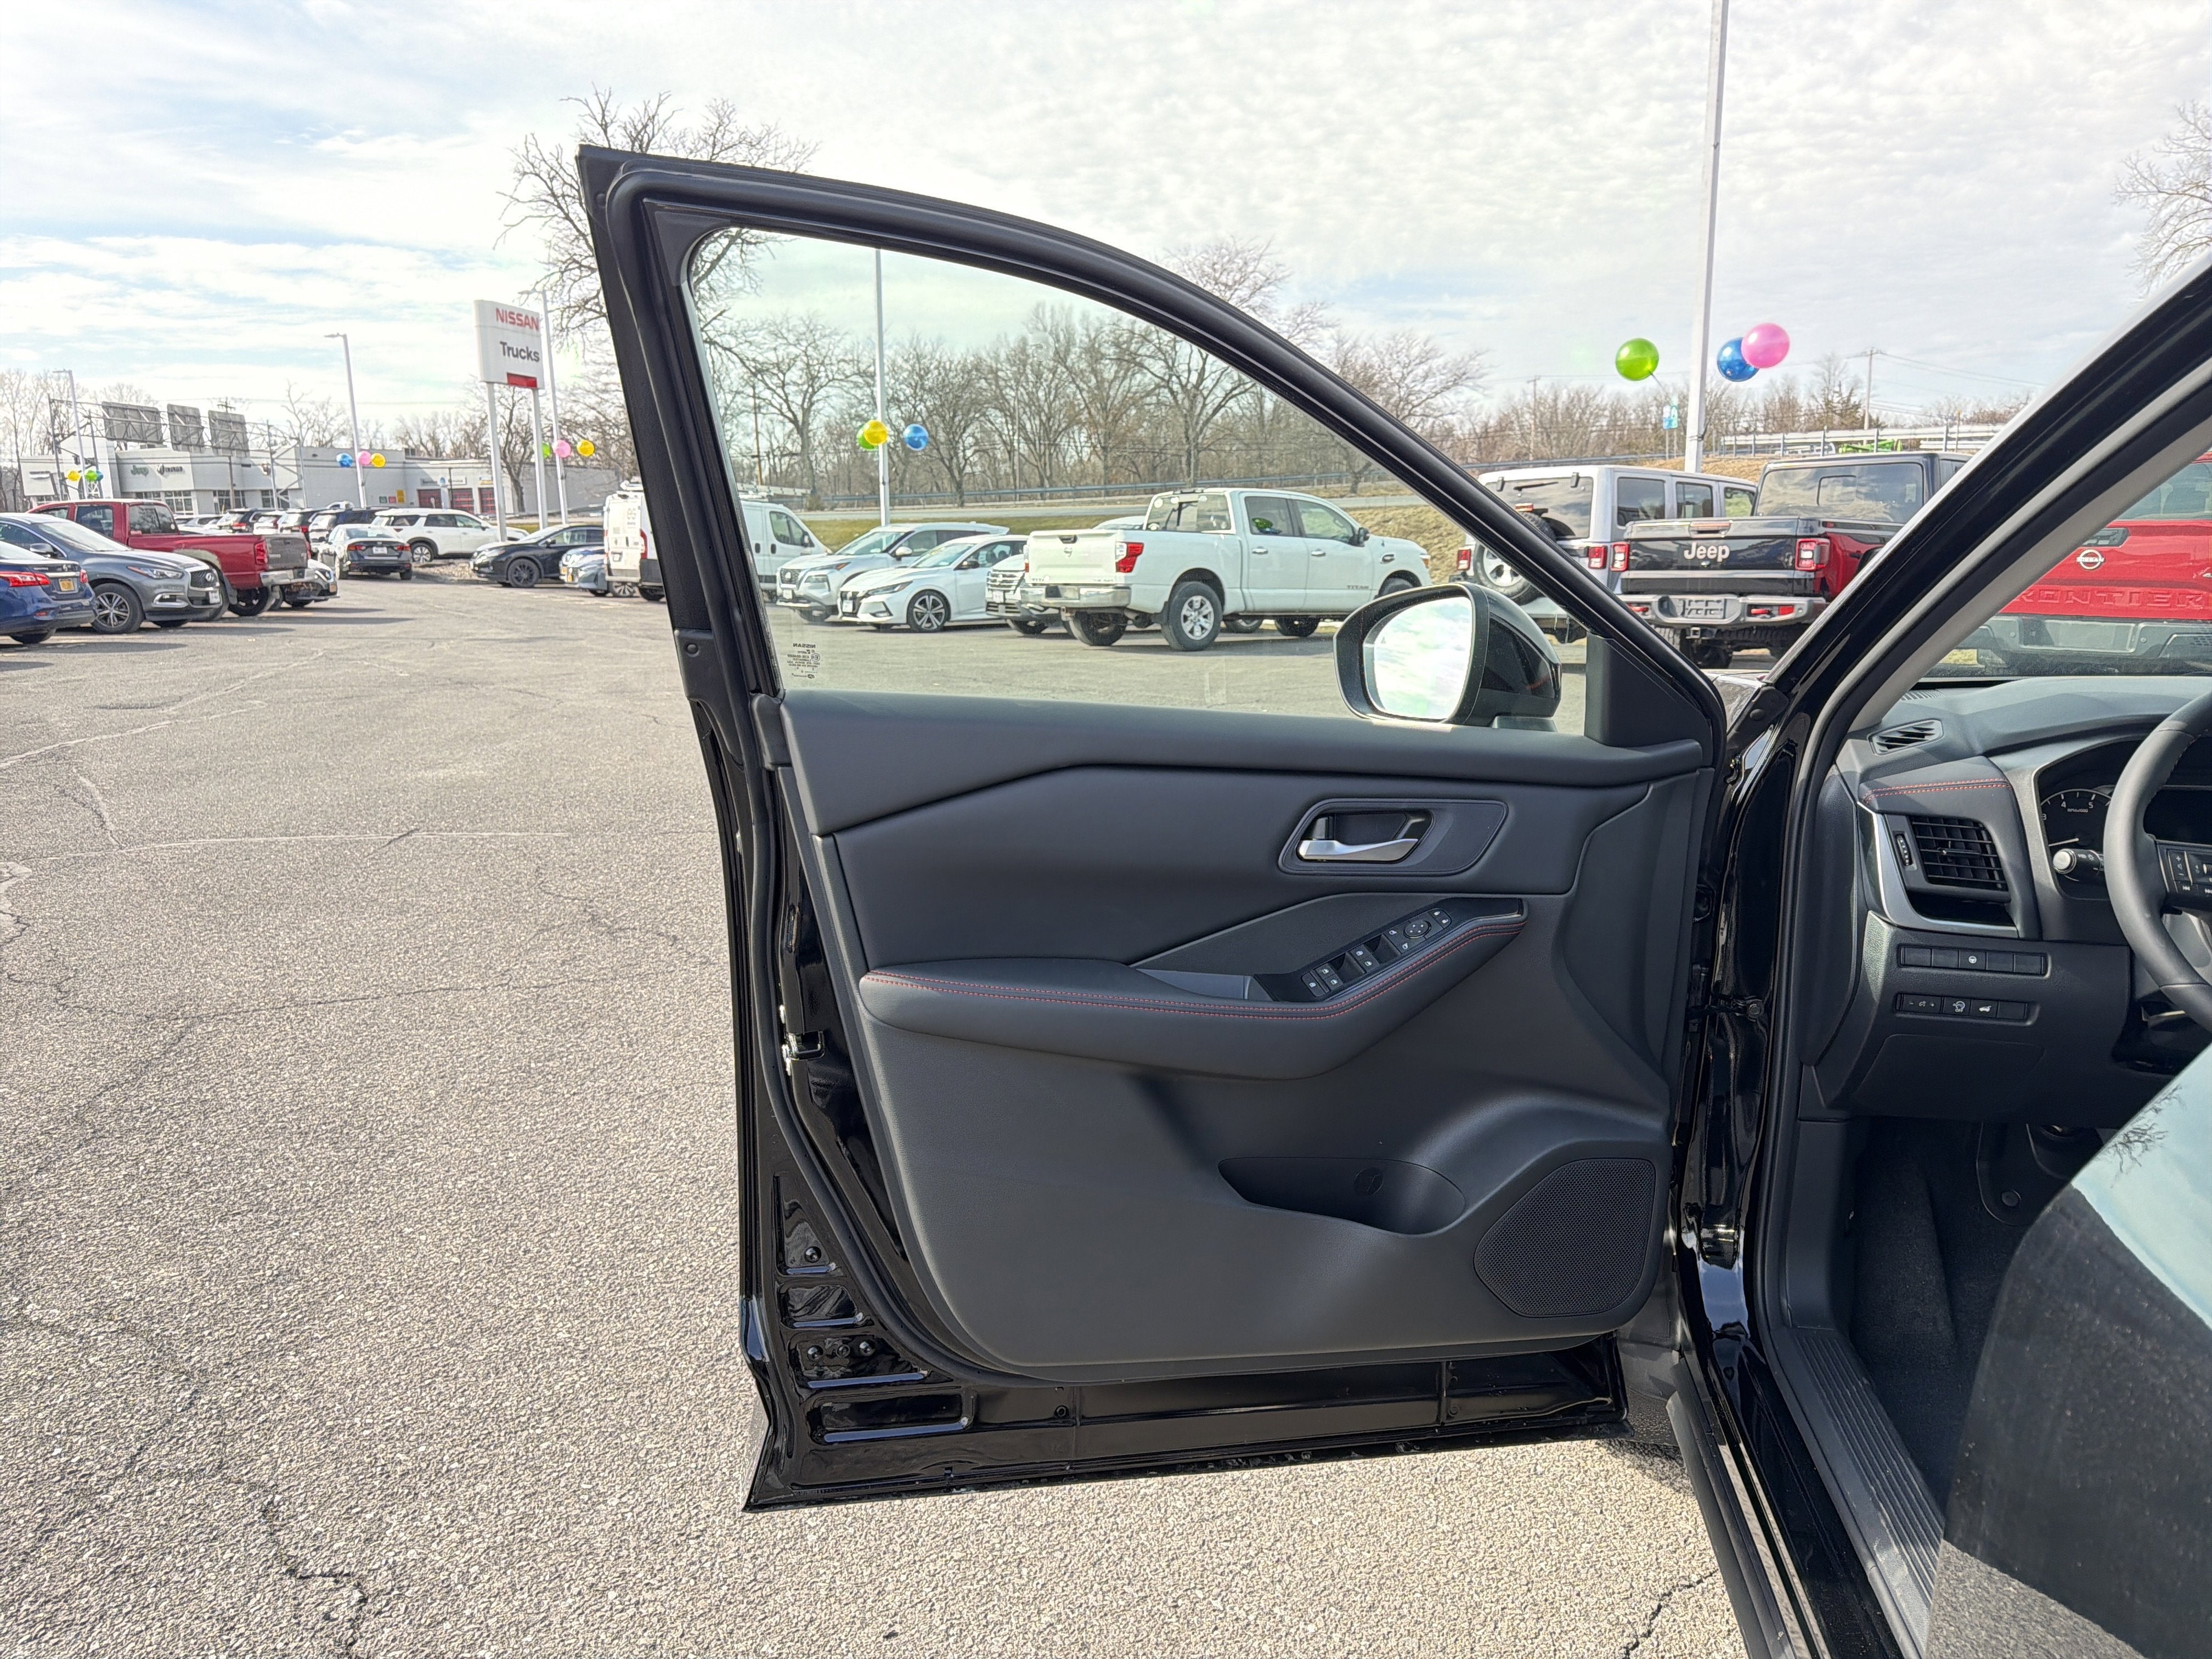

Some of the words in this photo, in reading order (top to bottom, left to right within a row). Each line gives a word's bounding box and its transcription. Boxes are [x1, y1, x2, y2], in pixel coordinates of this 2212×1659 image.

[495, 308, 539, 331] NISSAN
[499, 341, 540, 363] Trucks
[1684, 541, 1730, 562] Jeep
[2015, 589, 2203, 608] RONTIER
